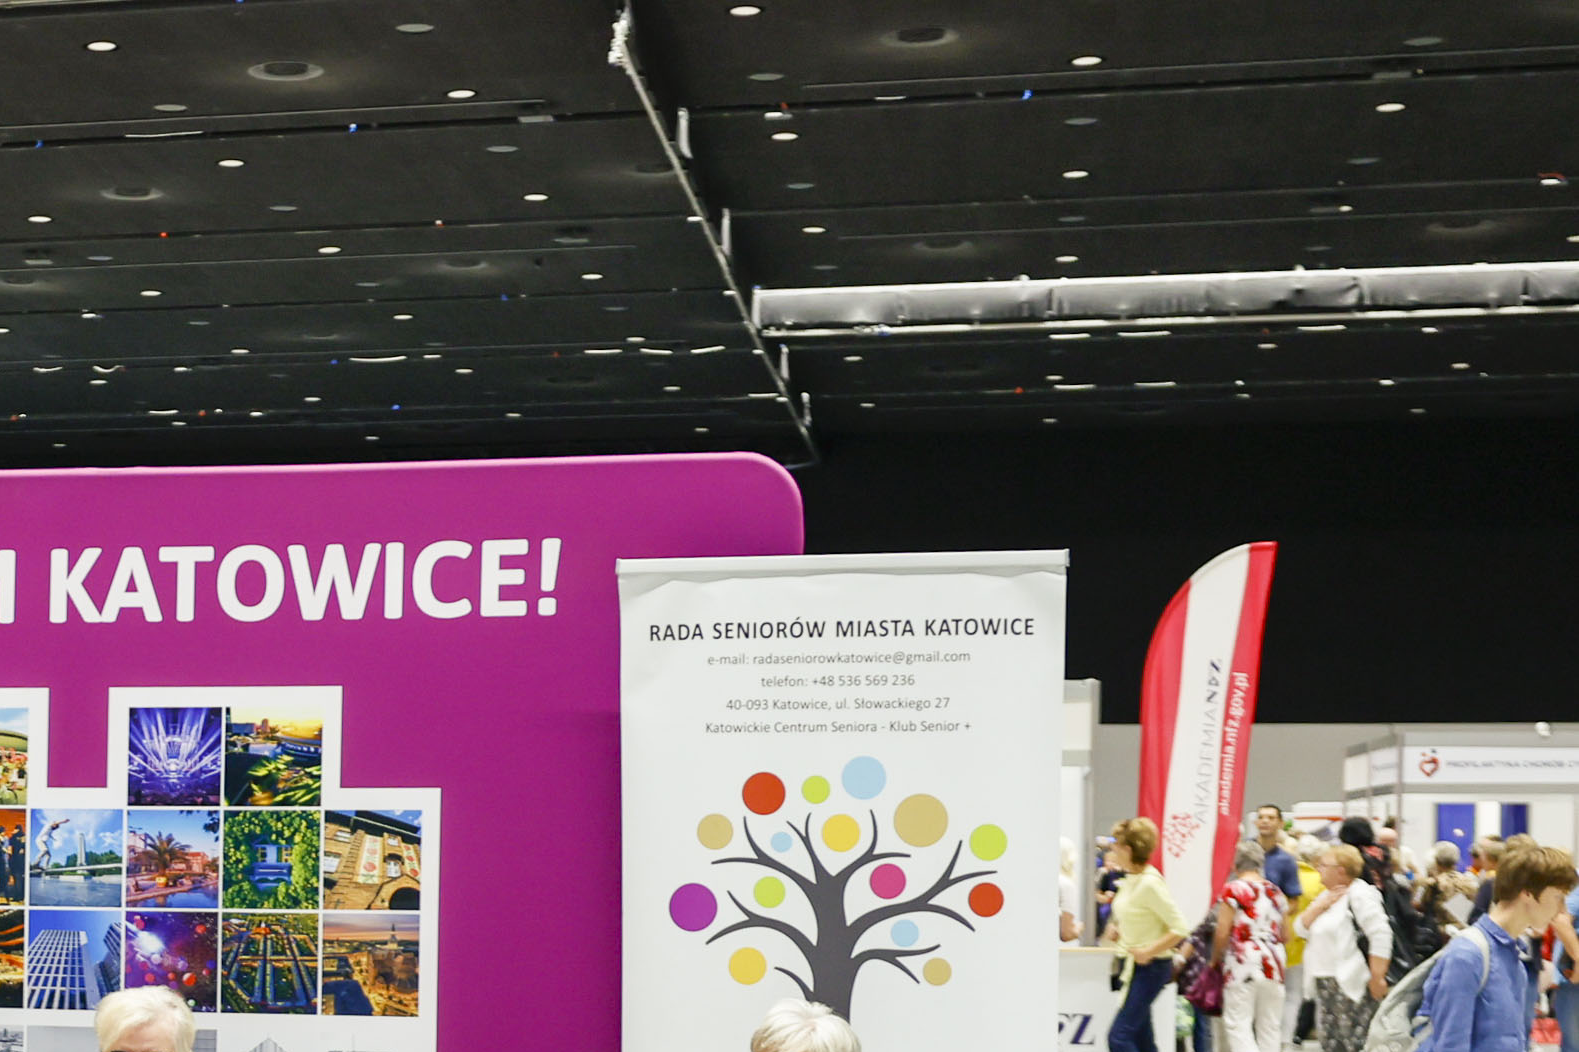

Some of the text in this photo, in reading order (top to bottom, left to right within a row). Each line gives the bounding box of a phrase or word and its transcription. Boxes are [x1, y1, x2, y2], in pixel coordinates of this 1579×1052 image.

[49, 537, 563, 624] KATOWICE!
[649, 616, 1036, 642] RADA SENIORÓW MIASTA KATOWICE
[707, 650, 971, 666] e-mail: radaseniorowkatowice@gmail.com
[761, 674, 915, 688] telefon: +48 536 569 236
[726, 697, 950, 712] 40-093 Katowice, ul. Słowackiego 27
[705, 721, 771, 734] Katowickie
[774, 721, 828, 733] Centrum
[831, 721, 878, 733] Seniora
[889, 720, 916, 732] Klub
[921, 720, 960, 732] Senior
